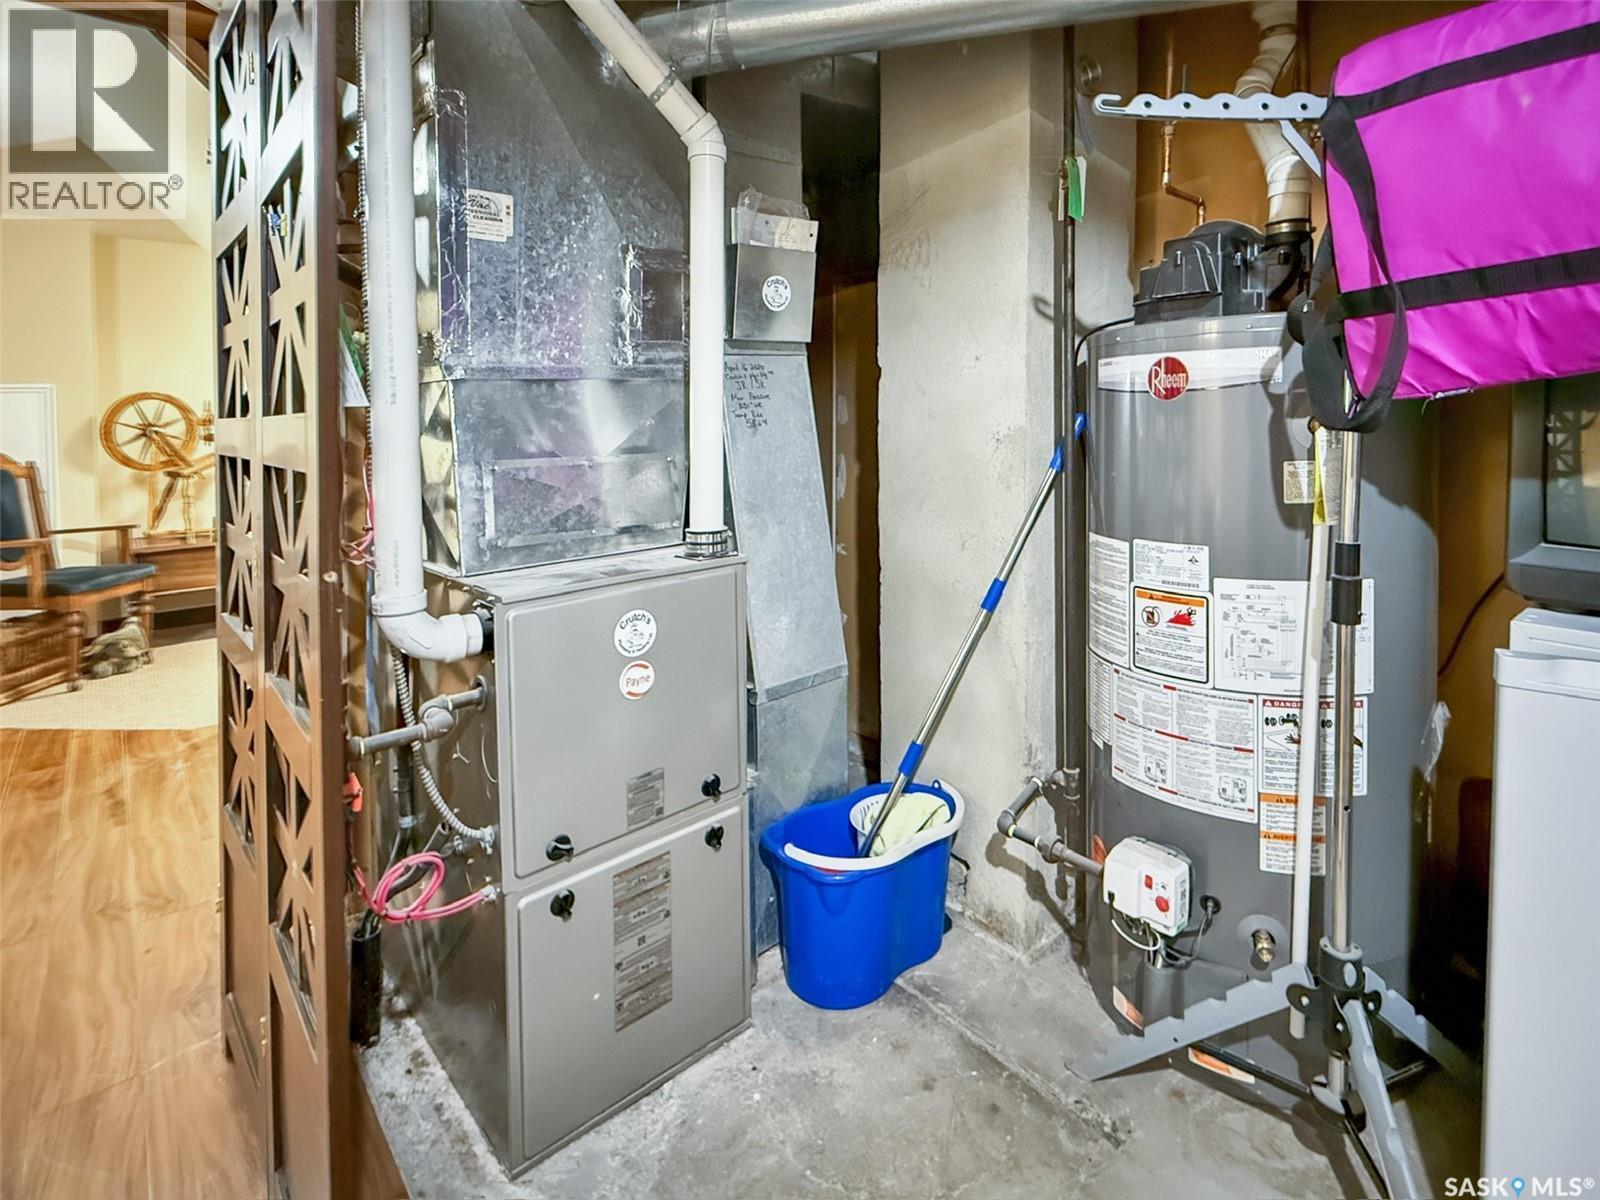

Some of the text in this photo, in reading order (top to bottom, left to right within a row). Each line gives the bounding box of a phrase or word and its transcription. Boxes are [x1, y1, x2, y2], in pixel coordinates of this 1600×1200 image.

[1151, 357, 1188, 395] Rheem
[619, 613, 651, 630] Crutch's
[626, 675, 650, 688] Payne
